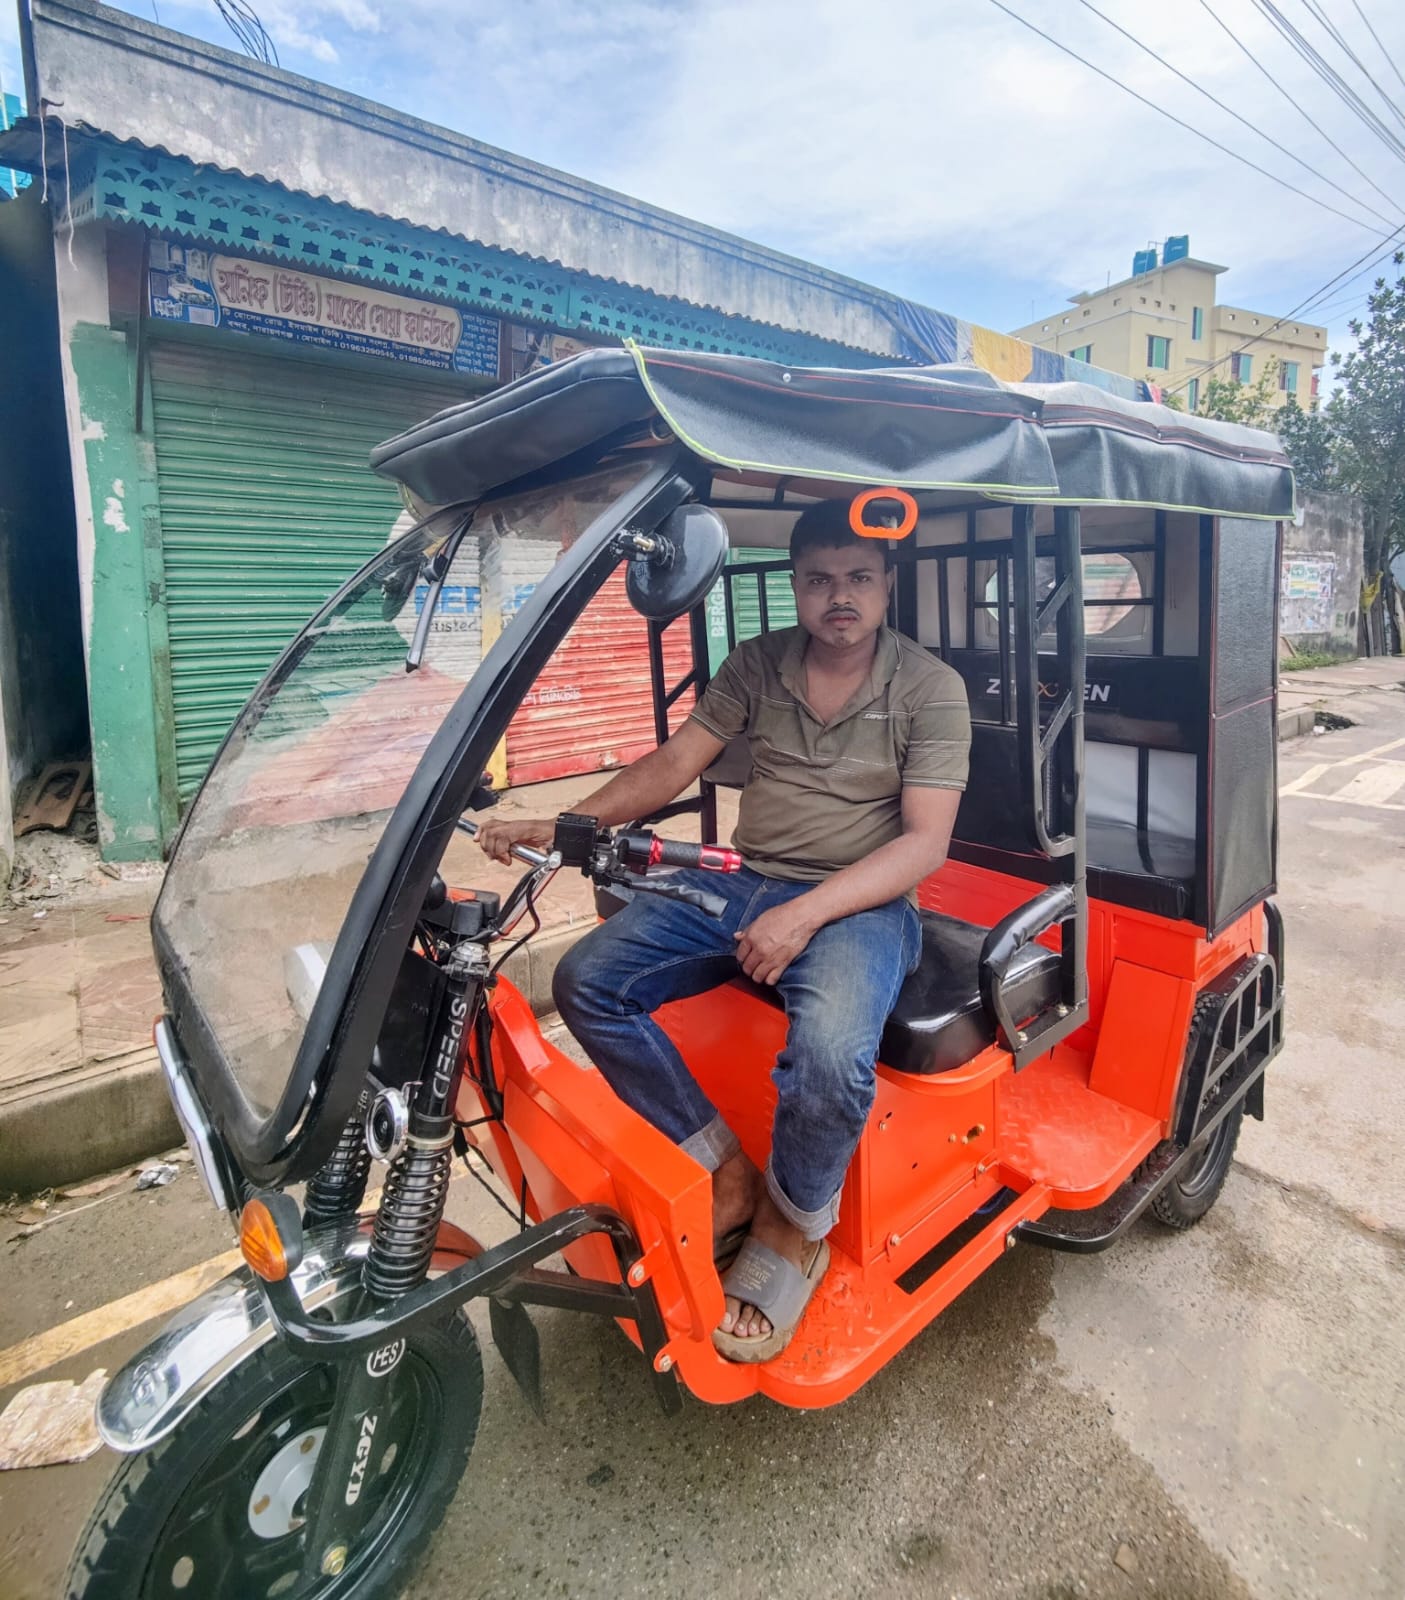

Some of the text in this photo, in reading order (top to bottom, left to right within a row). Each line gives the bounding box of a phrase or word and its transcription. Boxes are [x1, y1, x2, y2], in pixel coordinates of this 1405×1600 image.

[216, 264, 270, 309] হানিফ
[326, 293, 368, 330] মায়ের
[710, 576, 726, 637] BERGE
[373, 1341, 399, 1370] FES
[345, 1415, 378, 1506] ZGYD
